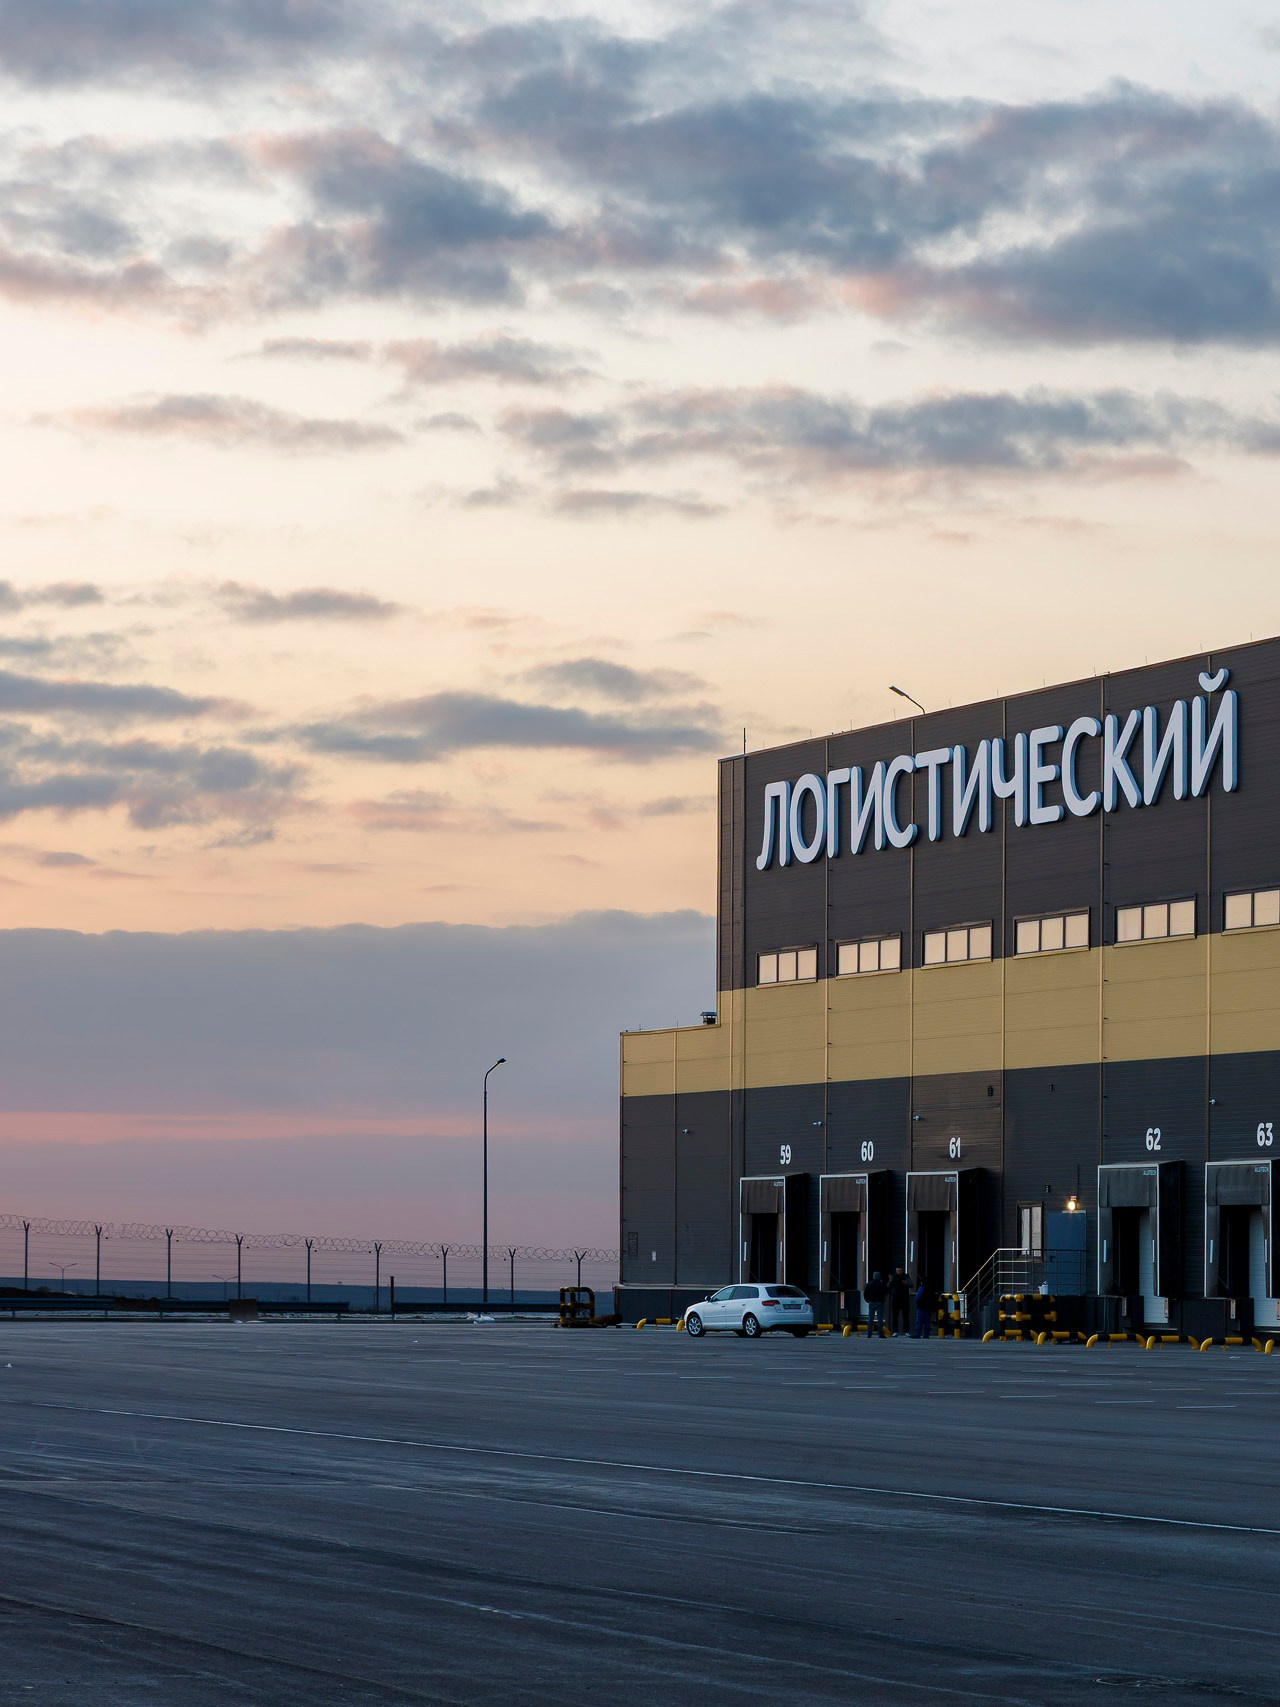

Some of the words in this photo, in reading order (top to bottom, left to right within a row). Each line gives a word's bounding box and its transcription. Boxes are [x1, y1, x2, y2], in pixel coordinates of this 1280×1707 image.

[755, 667, 1238, 871] ЛОГИСТИЧЕСКИЙ
[1145, 1128, 1161, 1150] 62
[1256, 1123, 1273, 1146] 63
[780, 1145, 792, 1164] 59
[861, 1141, 874, 1161] 60
[949, 1137, 961, 1158] 61
